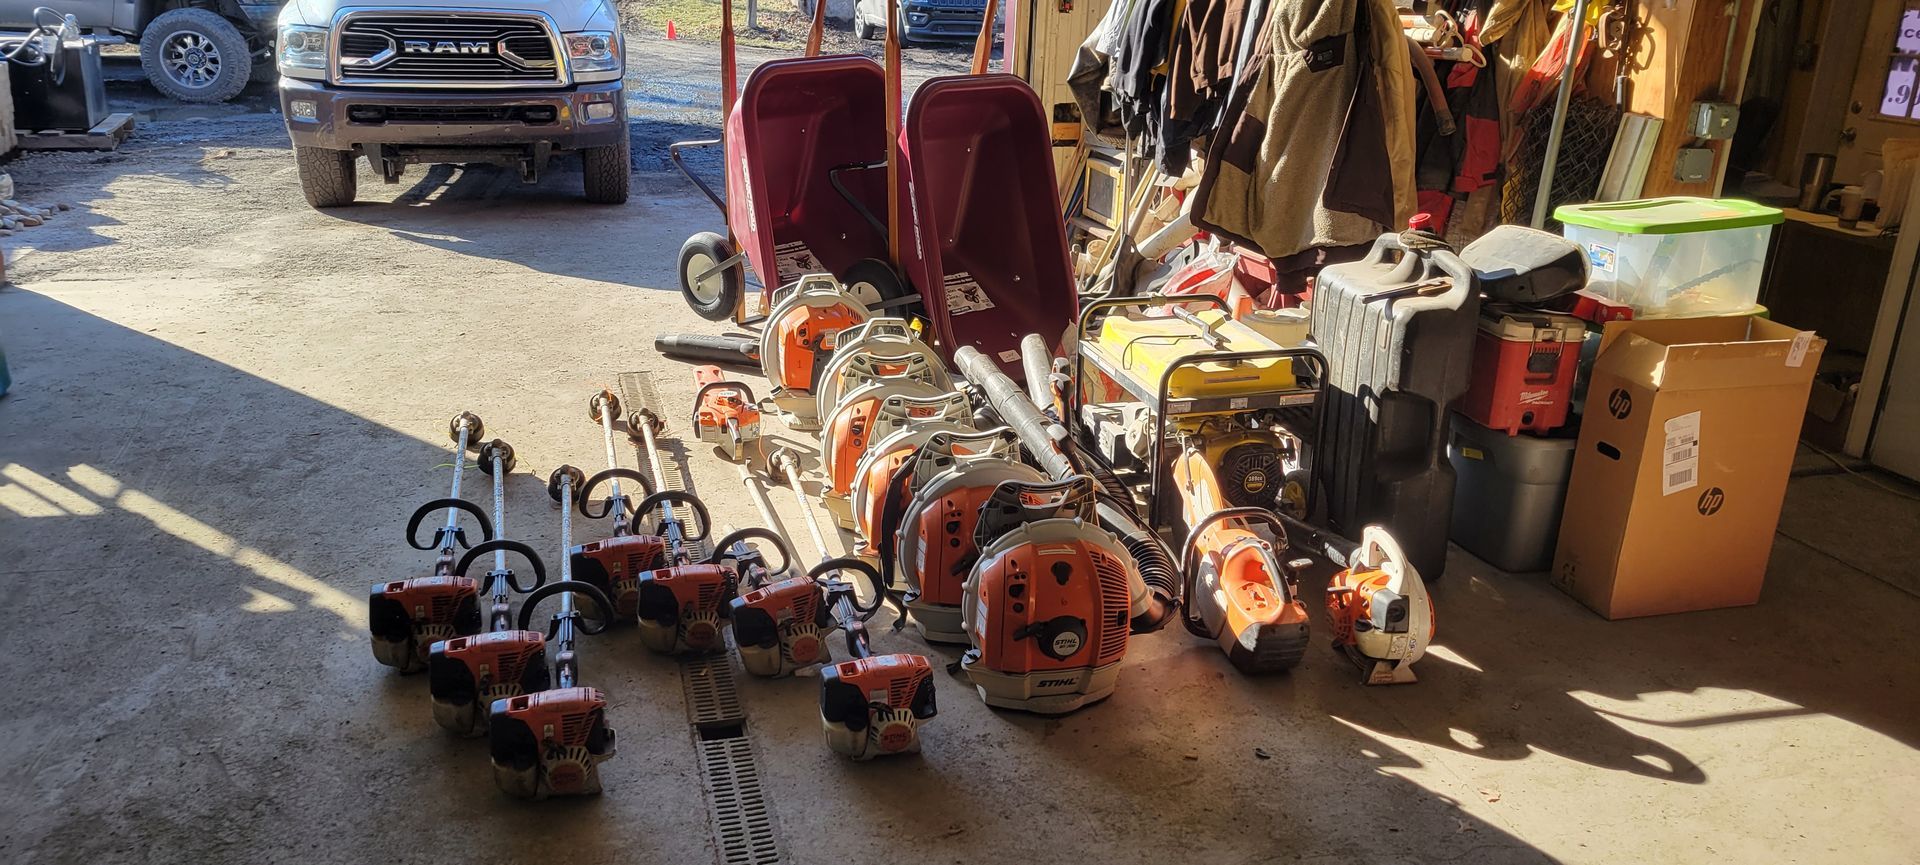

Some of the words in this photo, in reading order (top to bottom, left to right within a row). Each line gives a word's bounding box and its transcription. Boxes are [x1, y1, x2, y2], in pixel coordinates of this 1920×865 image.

[403, 40, 490, 54] RAM
[1610, 387, 1631, 419] hp
[1699, 488, 1723, 515] hp
[1036, 677, 1077, 688] STIHL
